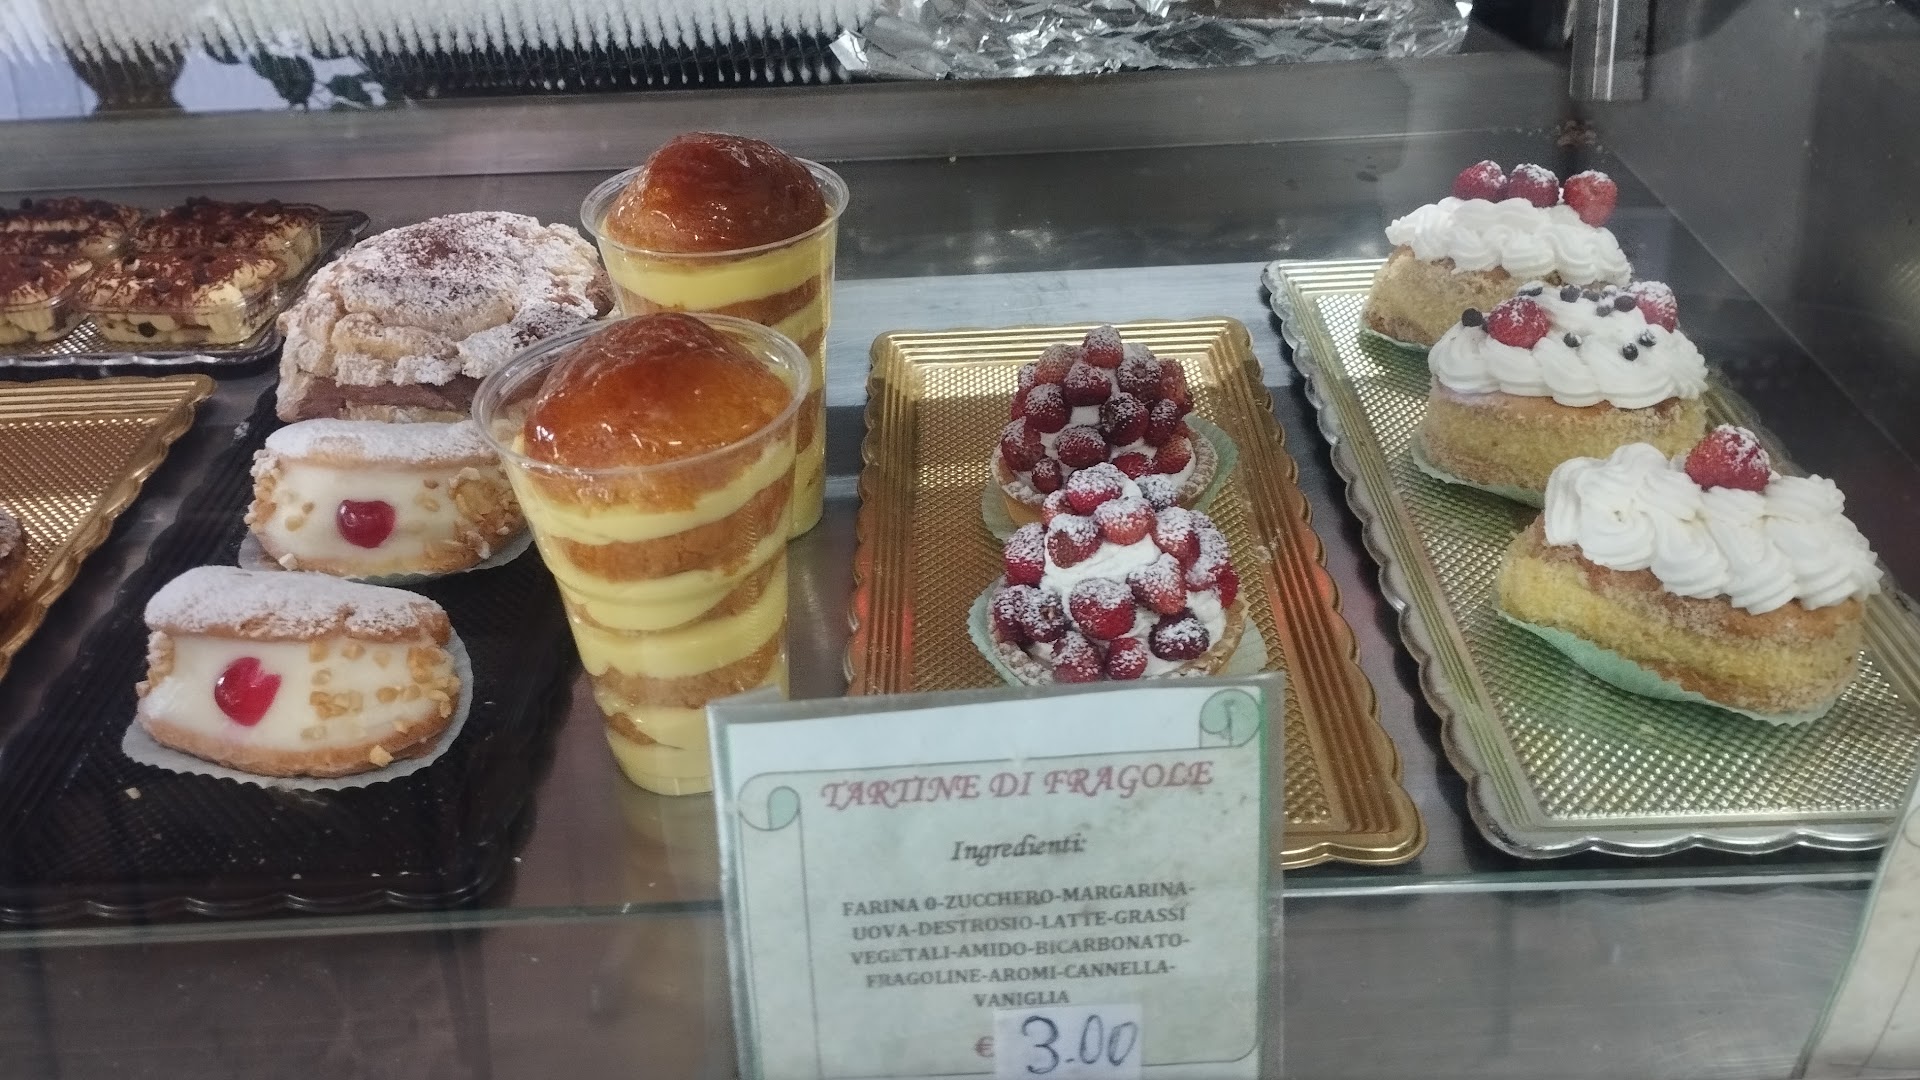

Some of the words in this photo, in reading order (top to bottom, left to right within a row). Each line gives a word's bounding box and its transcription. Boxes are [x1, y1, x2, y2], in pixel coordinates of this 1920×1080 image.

[820, 774, 981, 811] TARTINE
[988, 771, 1035, 798] DI
[1043, 760, 1215, 799] FRAGOLE
[842, 897, 920, 917] FARINA
[973, 989, 1071, 1008] VANIGLIA
